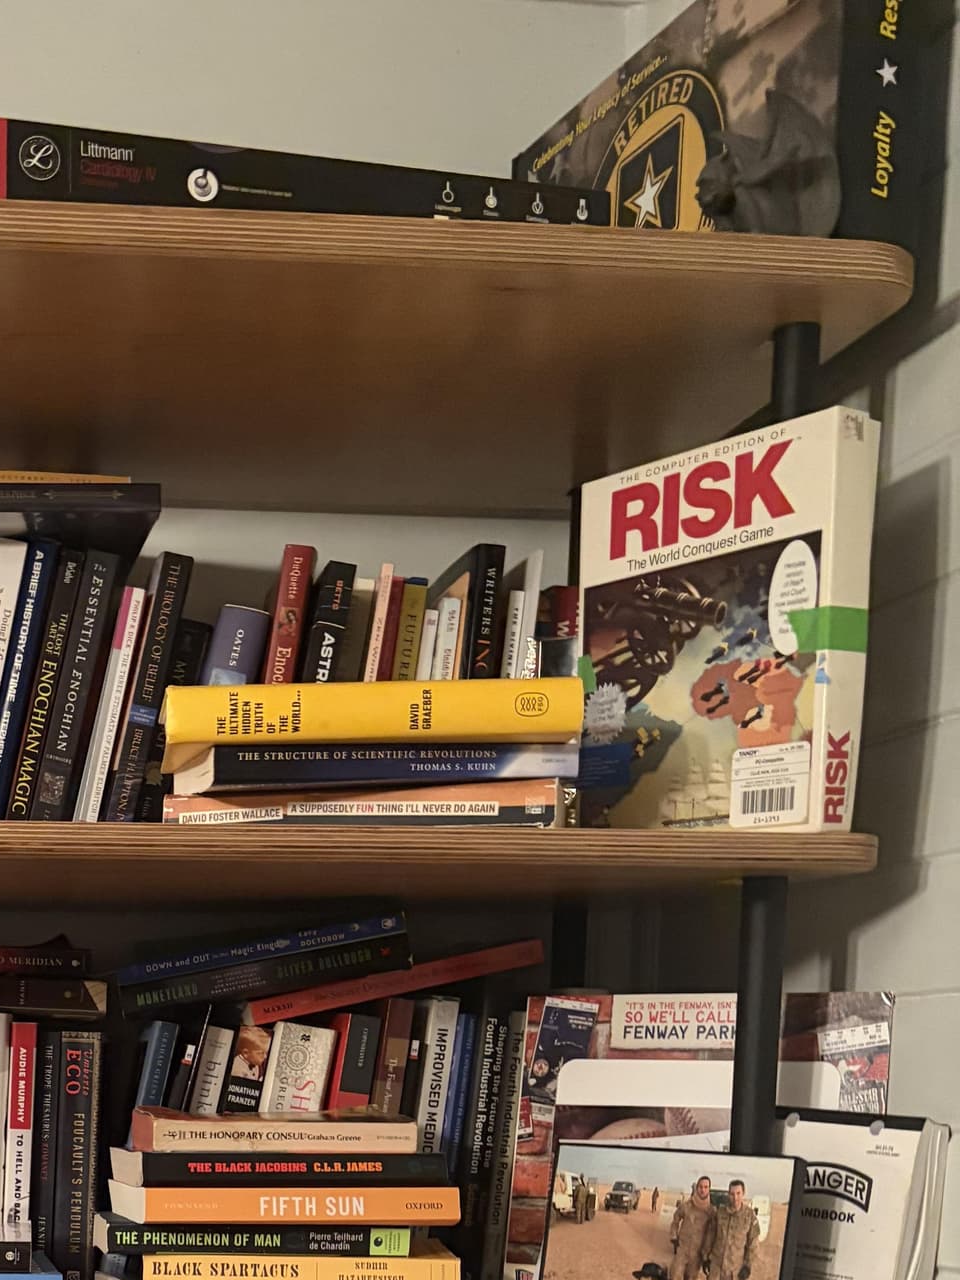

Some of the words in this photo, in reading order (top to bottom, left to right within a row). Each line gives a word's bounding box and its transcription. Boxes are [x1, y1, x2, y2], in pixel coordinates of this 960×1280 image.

[615, 77, 693, 154] RETIRED
[80, 141, 133, 161] Littmann
[871, 112, 896, 199] Loyalty
[620, 472, 640, 484] THE
[646, 453, 709, 477] COMPUTER
[715, 436, 764, 456] EDITION
[770, 429, 786, 439] OF
[610, 439, 795, 560] RISK
[627, 559, 646, 571] The
[649, 546, 679, 566] World
[682, 535, 737, 556] Conquest
[740, 527, 773, 542] Game
[229, 629, 244, 667] OATES
[27, 660, 57, 751] ENOCHIAN
[409, 704, 419, 729] DAVID
[421, 689, 432, 729] GRAEBER
[238, 752, 260, 761] THE
[264, 751, 328, 761] STRUCTURE
[333, 750, 347, 760] OF
[351, 750, 415, 760] SCIENTIFIC
[420, 749, 496, 759] REVOLUTIONS
[410, 763, 450, 772] THOMAS
[453, 763, 463, 772] S.
[466, 762, 496, 771] KUHN
[824, 731, 850, 823] RISK
[12, 756, 38, 815] MAGIC
[182, 813, 205, 823] DAVID
[208, 811, 241, 821] FOSTER
[243, 809, 280, 819] WALLACE
[291, 804, 297, 813] A
[300, 803, 353, 813] SUPPOSEDLY
[356, 803, 373, 813] FUN
[376, 803, 403, 813] THING
[406, 803, 420, 812] I'LL
[422, 803, 451, 812] NEVER
[454, 803, 465, 812] DO
[467, 803, 495, 813] AGAIN
[626, 1012, 643, 1023] SO
[649, 1011, 689, 1023] WE'LL
[696, 1010, 735, 1023] CALL
[623, 1026, 688, 1040] FENWAY
[259, 1196, 318, 1216] FIFTH
[325, 1196, 365, 1216] SUN
[405, 1202, 443, 1210] OXFORD
[115, 1231, 139, 1245] THE
[143, 1231, 231, 1246] PHENOMENON
[234, 1232, 249, 1246] OF
[252, 1233, 281, 1246] MAN
[151, 1261, 202, 1276] BLACK
[209, 1263, 299, 1277] SPARTACUS
